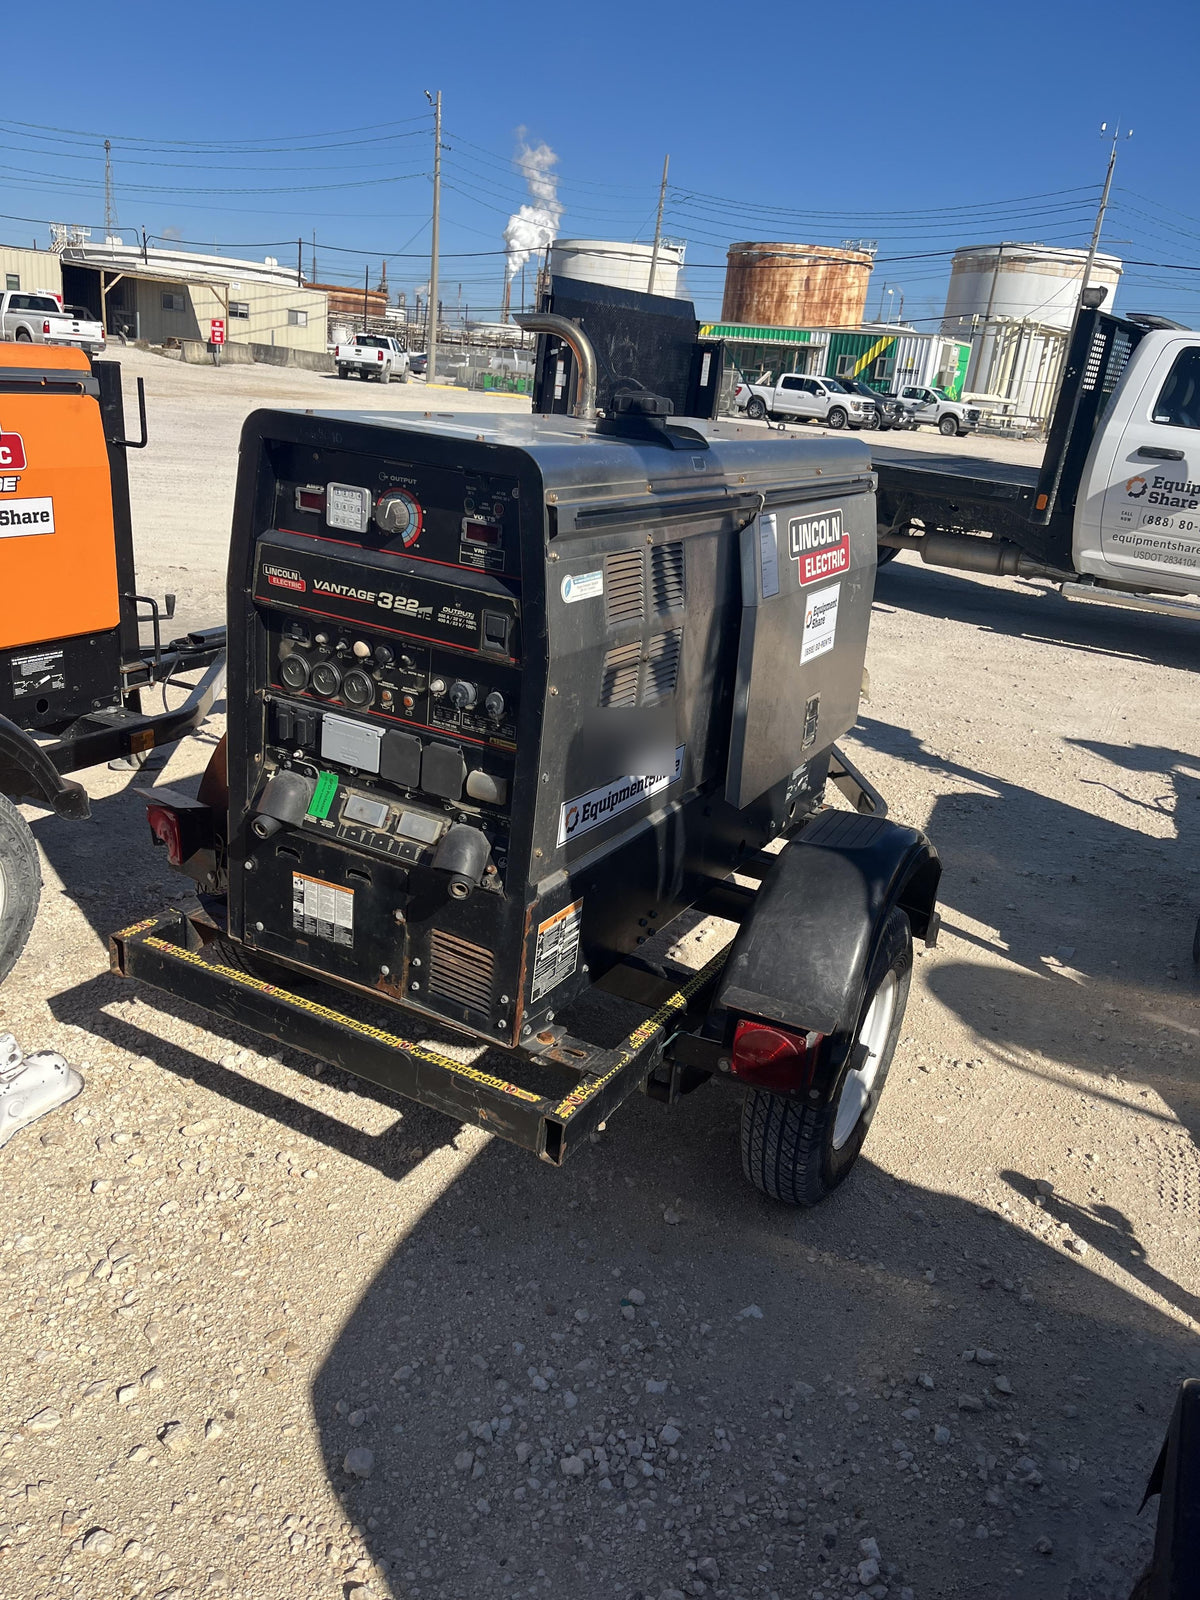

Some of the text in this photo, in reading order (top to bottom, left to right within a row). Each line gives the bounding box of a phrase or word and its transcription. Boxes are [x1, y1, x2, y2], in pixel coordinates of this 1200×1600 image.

[390, 475, 417, 485] OUTPUT
[1152, 476, 1200, 496] Equip
[1148, 492, 1198, 509] Share
[0, 510, 50, 526] Share
[473, 513, 496, 522] VOLTS
[1142, 514, 1200, 532] (888) 80-
[792, 516, 840, 552] LINCOLN
[805, 548, 846, 578] ELECTRIC
[1133, 550, 1197, 567] USDOT 2834104
[264, 566, 298, 580] LINCOLN
[273, 578, 302, 590] ELECTRIC
[313, 580, 420, 612] VANTAGE 322
[442, 606, 472, 617] OUTPUT
[813, 598, 837, 616] Equipment
[812, 616, 825, 629] Share
[236, 975, 262, 988] HERE
[274, 988, 288, 998] NE
[288, 994, 308, 1008] PAS
[309, 1002, 340, 1018] TENEZ
[340, 1016, 380, 1038] DEBOUT
[429, 1053, 443, 1064] SE
[444, 1059, 473, 1076] PARE
[475, 1074, 503, 1087] AQUI
